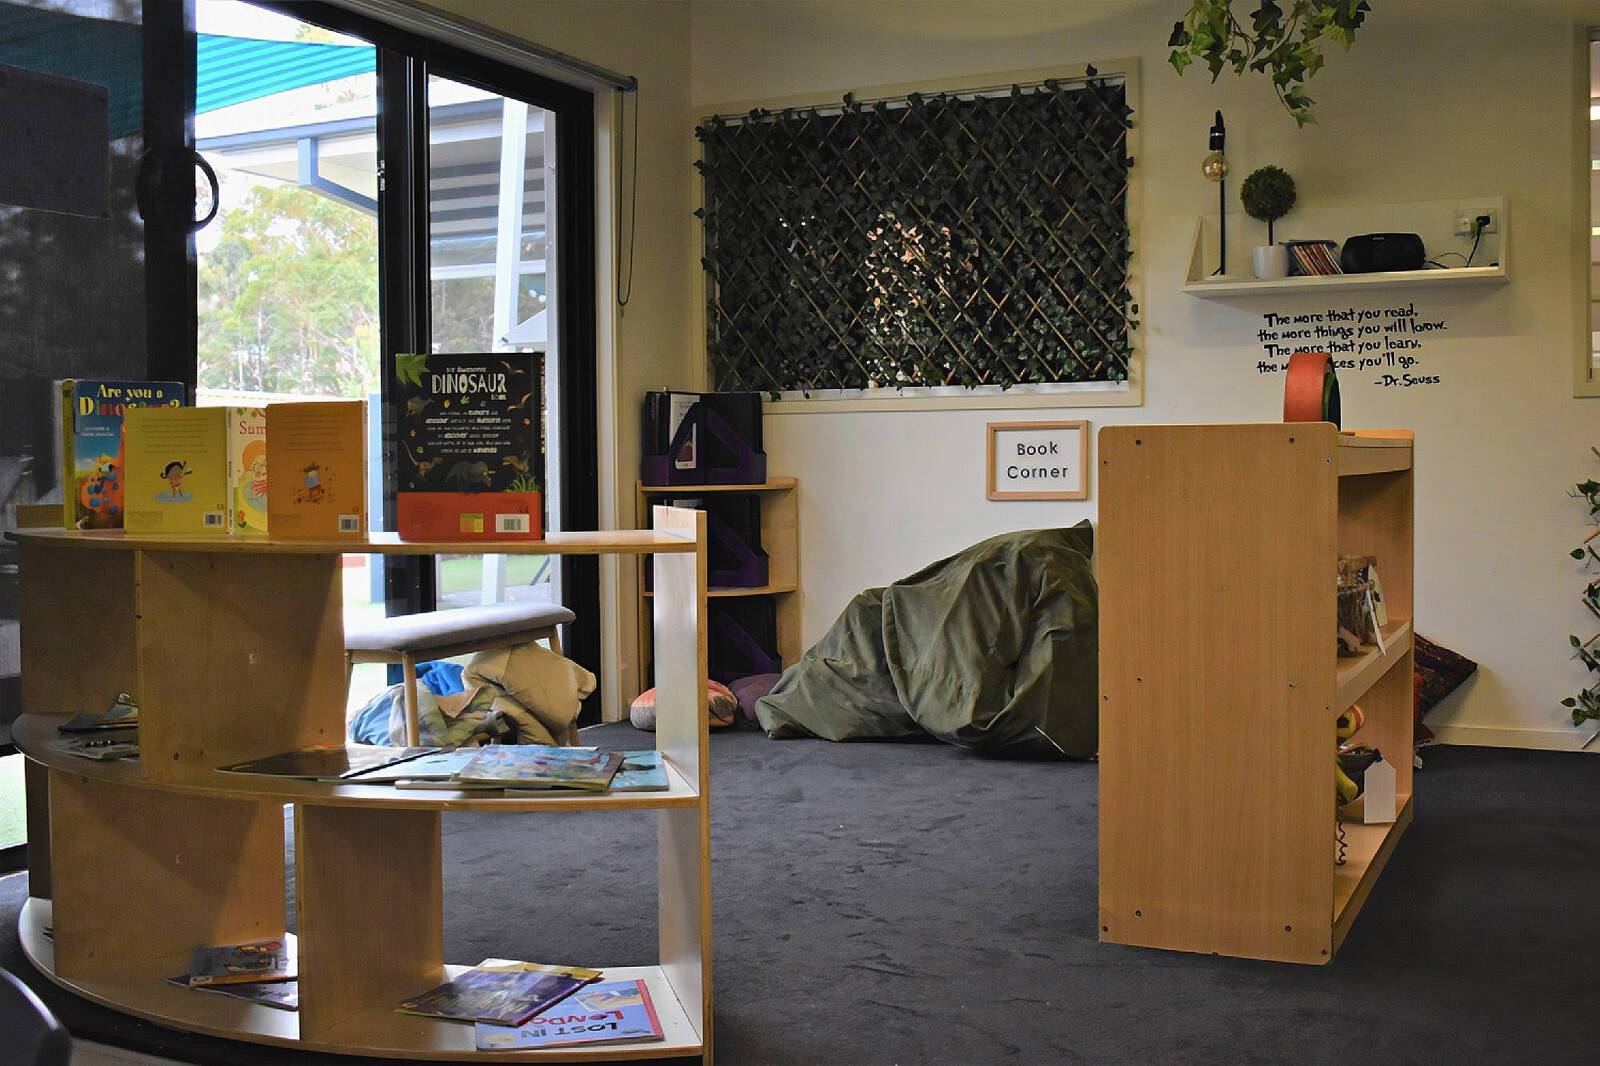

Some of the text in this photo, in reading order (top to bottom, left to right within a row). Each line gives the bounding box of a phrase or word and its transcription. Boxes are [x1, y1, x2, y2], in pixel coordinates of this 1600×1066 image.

[1264, 313, 1290, 327] The
[1293, 313, 1323, 323] more
[1326, 308, 1355, 321] that
[1358, 310, 1380, 323] you
[1258, 318, 1447, 342] the more things you will know.
[1264, 344, 1290, 358] The
[1294, 342, 1324, 353] more
[1326, 338, 1355, 352] that
[1358, 341, 1380, 354] you
[1257, 361, 1277, 373] the
[1334, 359, 1355, 369] ces
[1359, 353, 1394, 370] you'll
[1398, 356, 1419, 369] go.
[431, 373, 507, 394] DINOSAUR
[97, 384, 164, 402] Are you a
[1017, 441, 1058, 456] Book
[1007, 465, 1068, 479] Corner
[531, 1010, 624, 1025] LONDO
[521, 1022, 618, 1038] LOST IN
